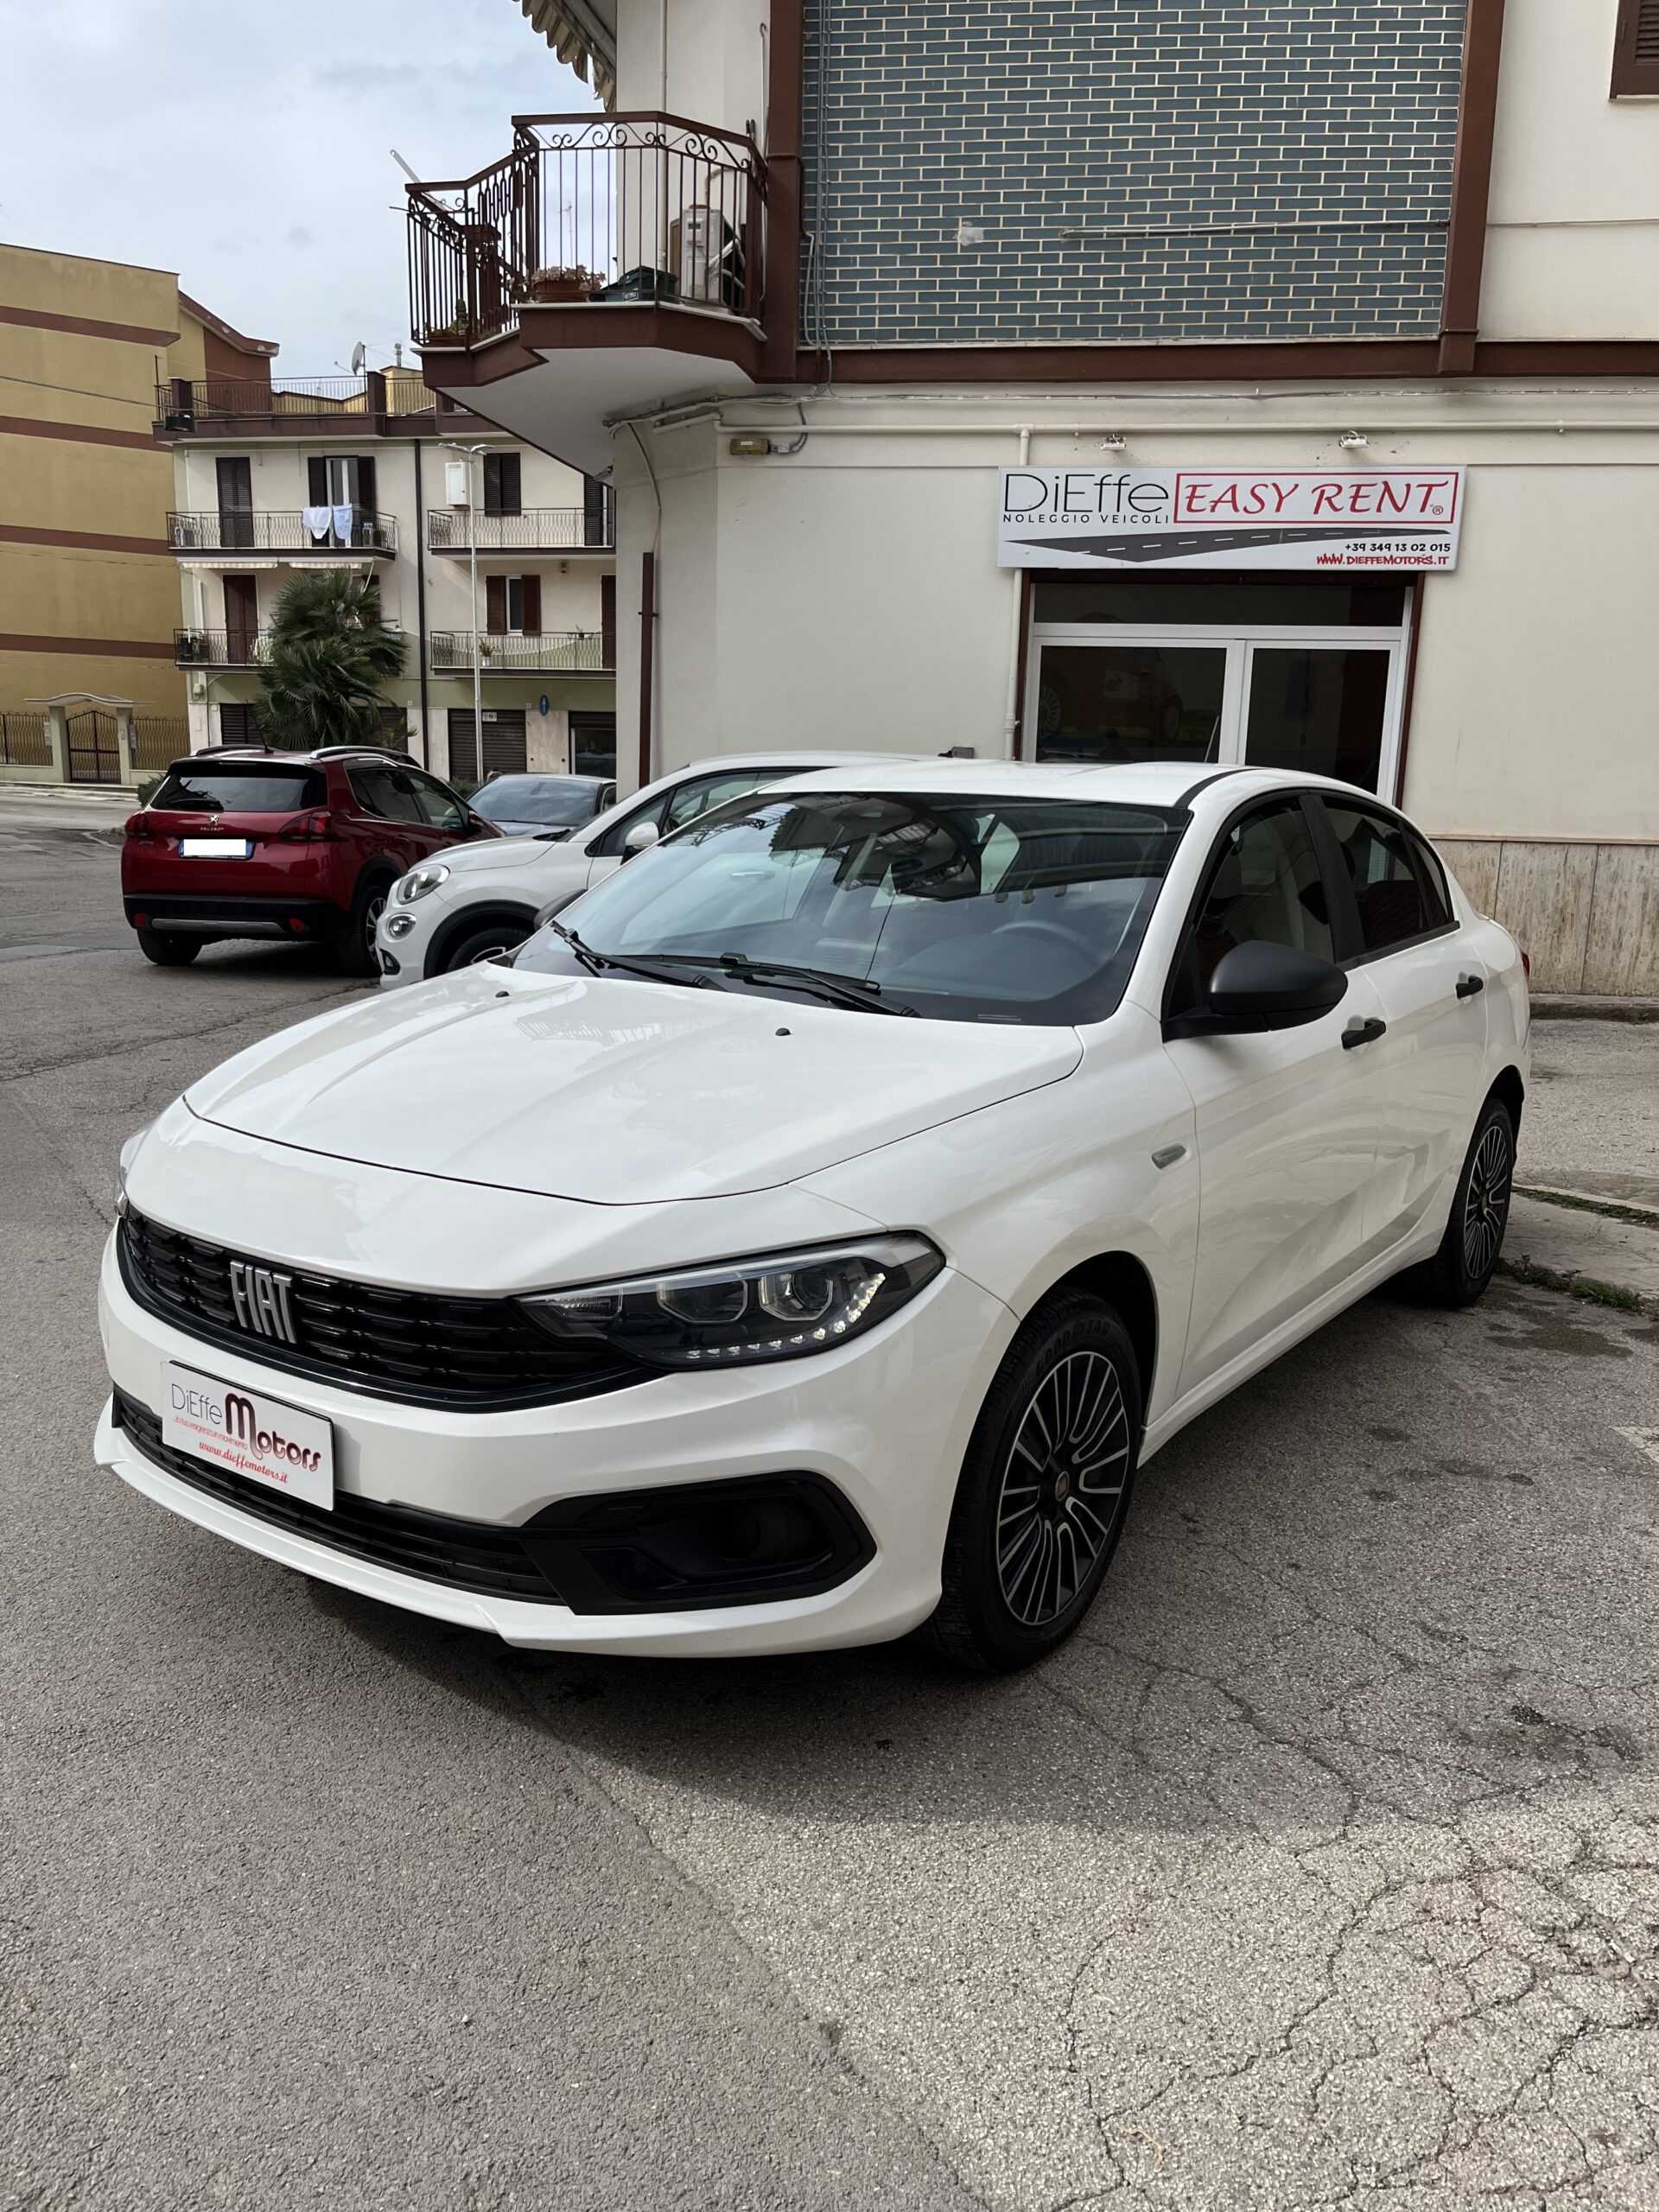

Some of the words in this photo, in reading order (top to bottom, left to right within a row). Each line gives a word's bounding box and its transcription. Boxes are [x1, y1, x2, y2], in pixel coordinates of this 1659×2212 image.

[1005, 474, 1169, 512] DiEffe
[1185, 482, 1299, 514] EASY
[1003, 513, 1090, 524] NOLEGGIO
[1100, 514, 1168, 524] VEICOLI
[1344, 543, 1366, 552] +39
[1370, 543, 1391, 552] 349
[1395, 543, 1408, 552] 13
[1410, 543, 1427, 552] 02
[1429, 543, 1452, 552] 015
[230, 1260, 297, 1344] FIAT
[171, 1382, 223, 1425] DiEffe
[199, 1440, 288, 1484] www.dieffemotors.it
